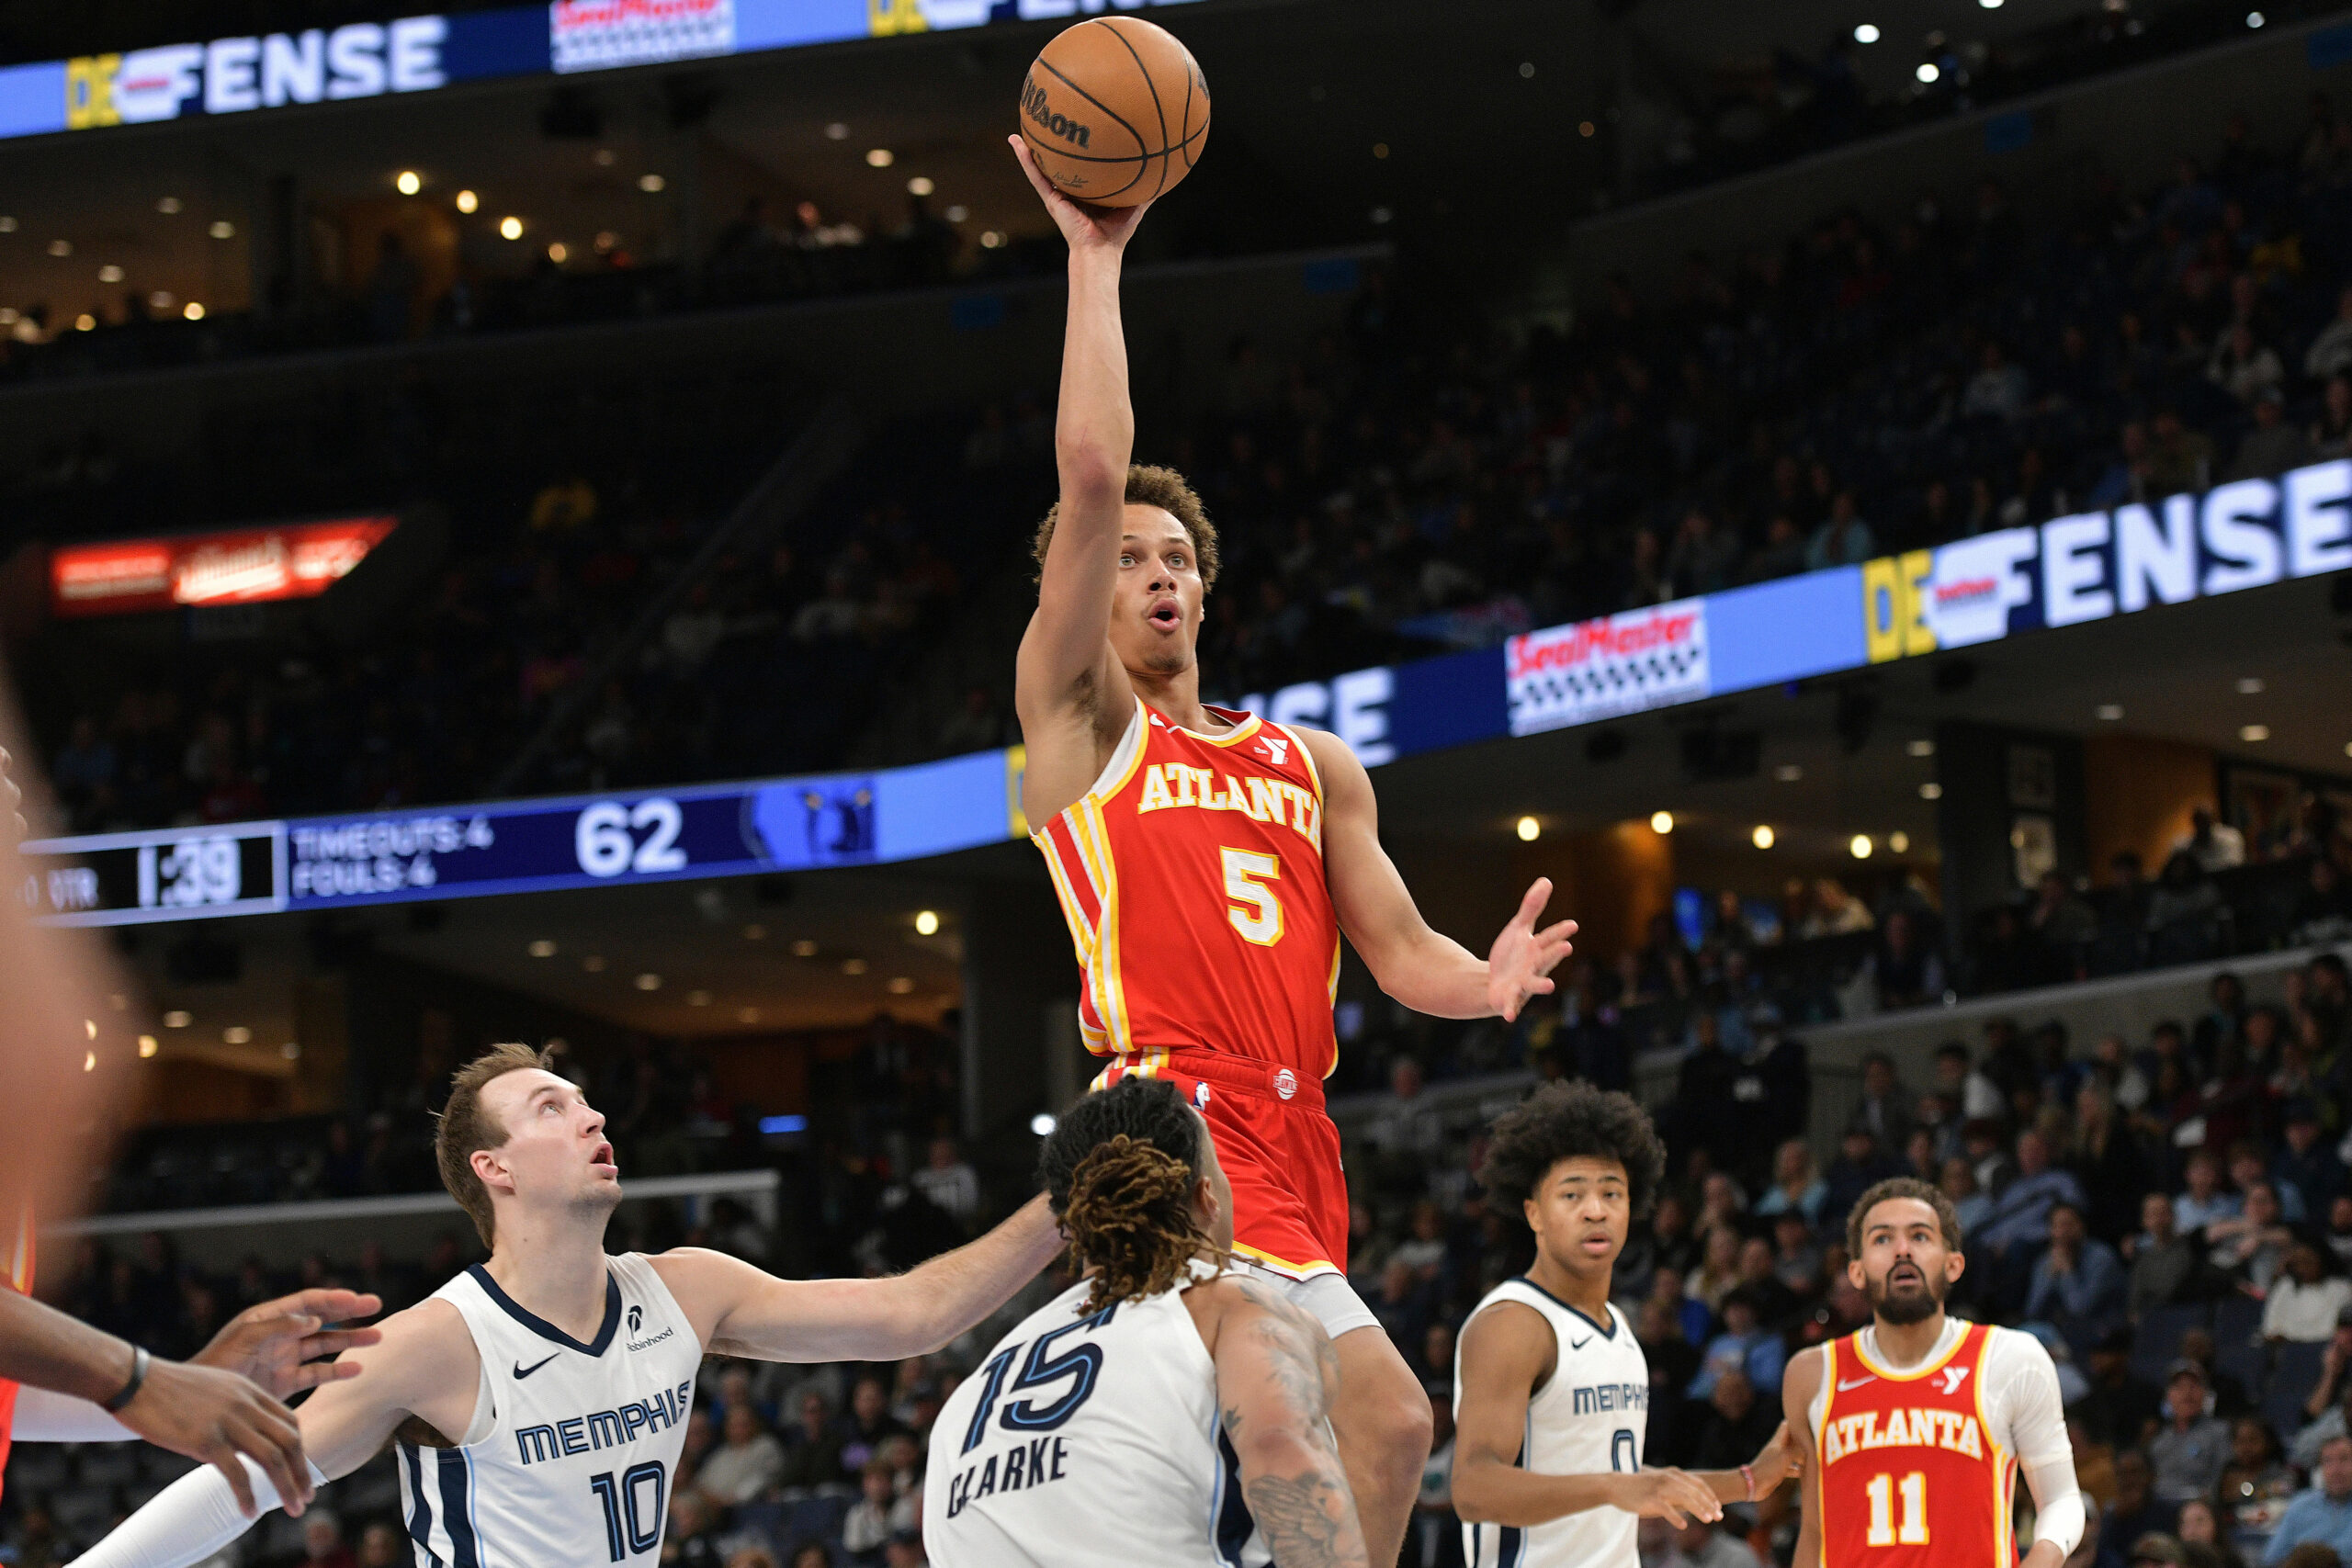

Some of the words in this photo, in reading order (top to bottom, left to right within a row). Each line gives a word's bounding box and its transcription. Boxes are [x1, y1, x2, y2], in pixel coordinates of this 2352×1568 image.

[575, 796, 687, 878] 62
[1137, 761, 1322, 860] ATLANTA
[1219, 844, 1284, 947] 5
[959, 1299, 1122, 1459] 15
[514, 1380, 691, 1466] MEMPHIS
[1825, 1407, 1984, 1467] ATLANTA
[590, 1460, 665, 1563] 10
[946, 1436, 1072, 1519] CLARKE
[1866, 1471, 1930, 1547] 11
